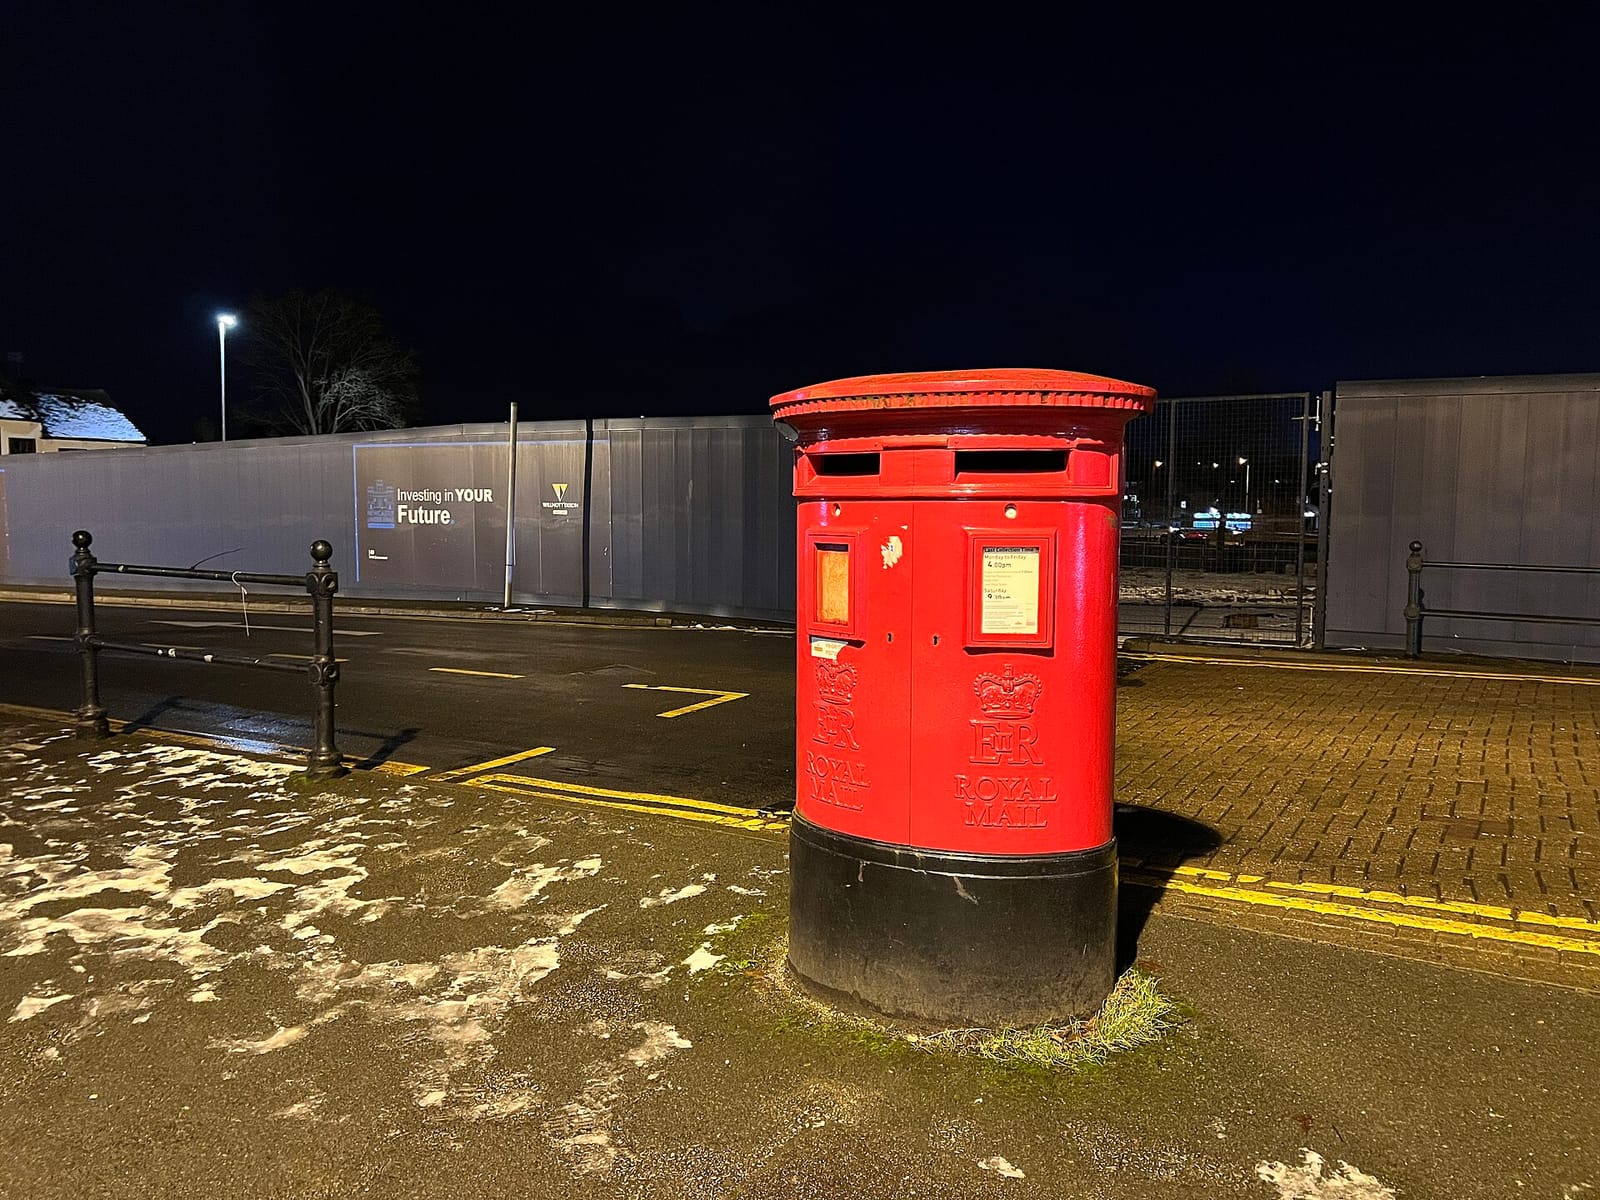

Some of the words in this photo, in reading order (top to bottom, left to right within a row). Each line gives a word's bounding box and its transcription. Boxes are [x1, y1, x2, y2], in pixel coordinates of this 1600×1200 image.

[397, 488, 442, 505] Investing
[444, 488, 454, 502] in
[455, 488, 493, 502] YOUR
[806, 749, 871, 789] ROYAL
[953, 774, 1058, 802] ROYAL
[964, 801, 1048, 828] MAIL
